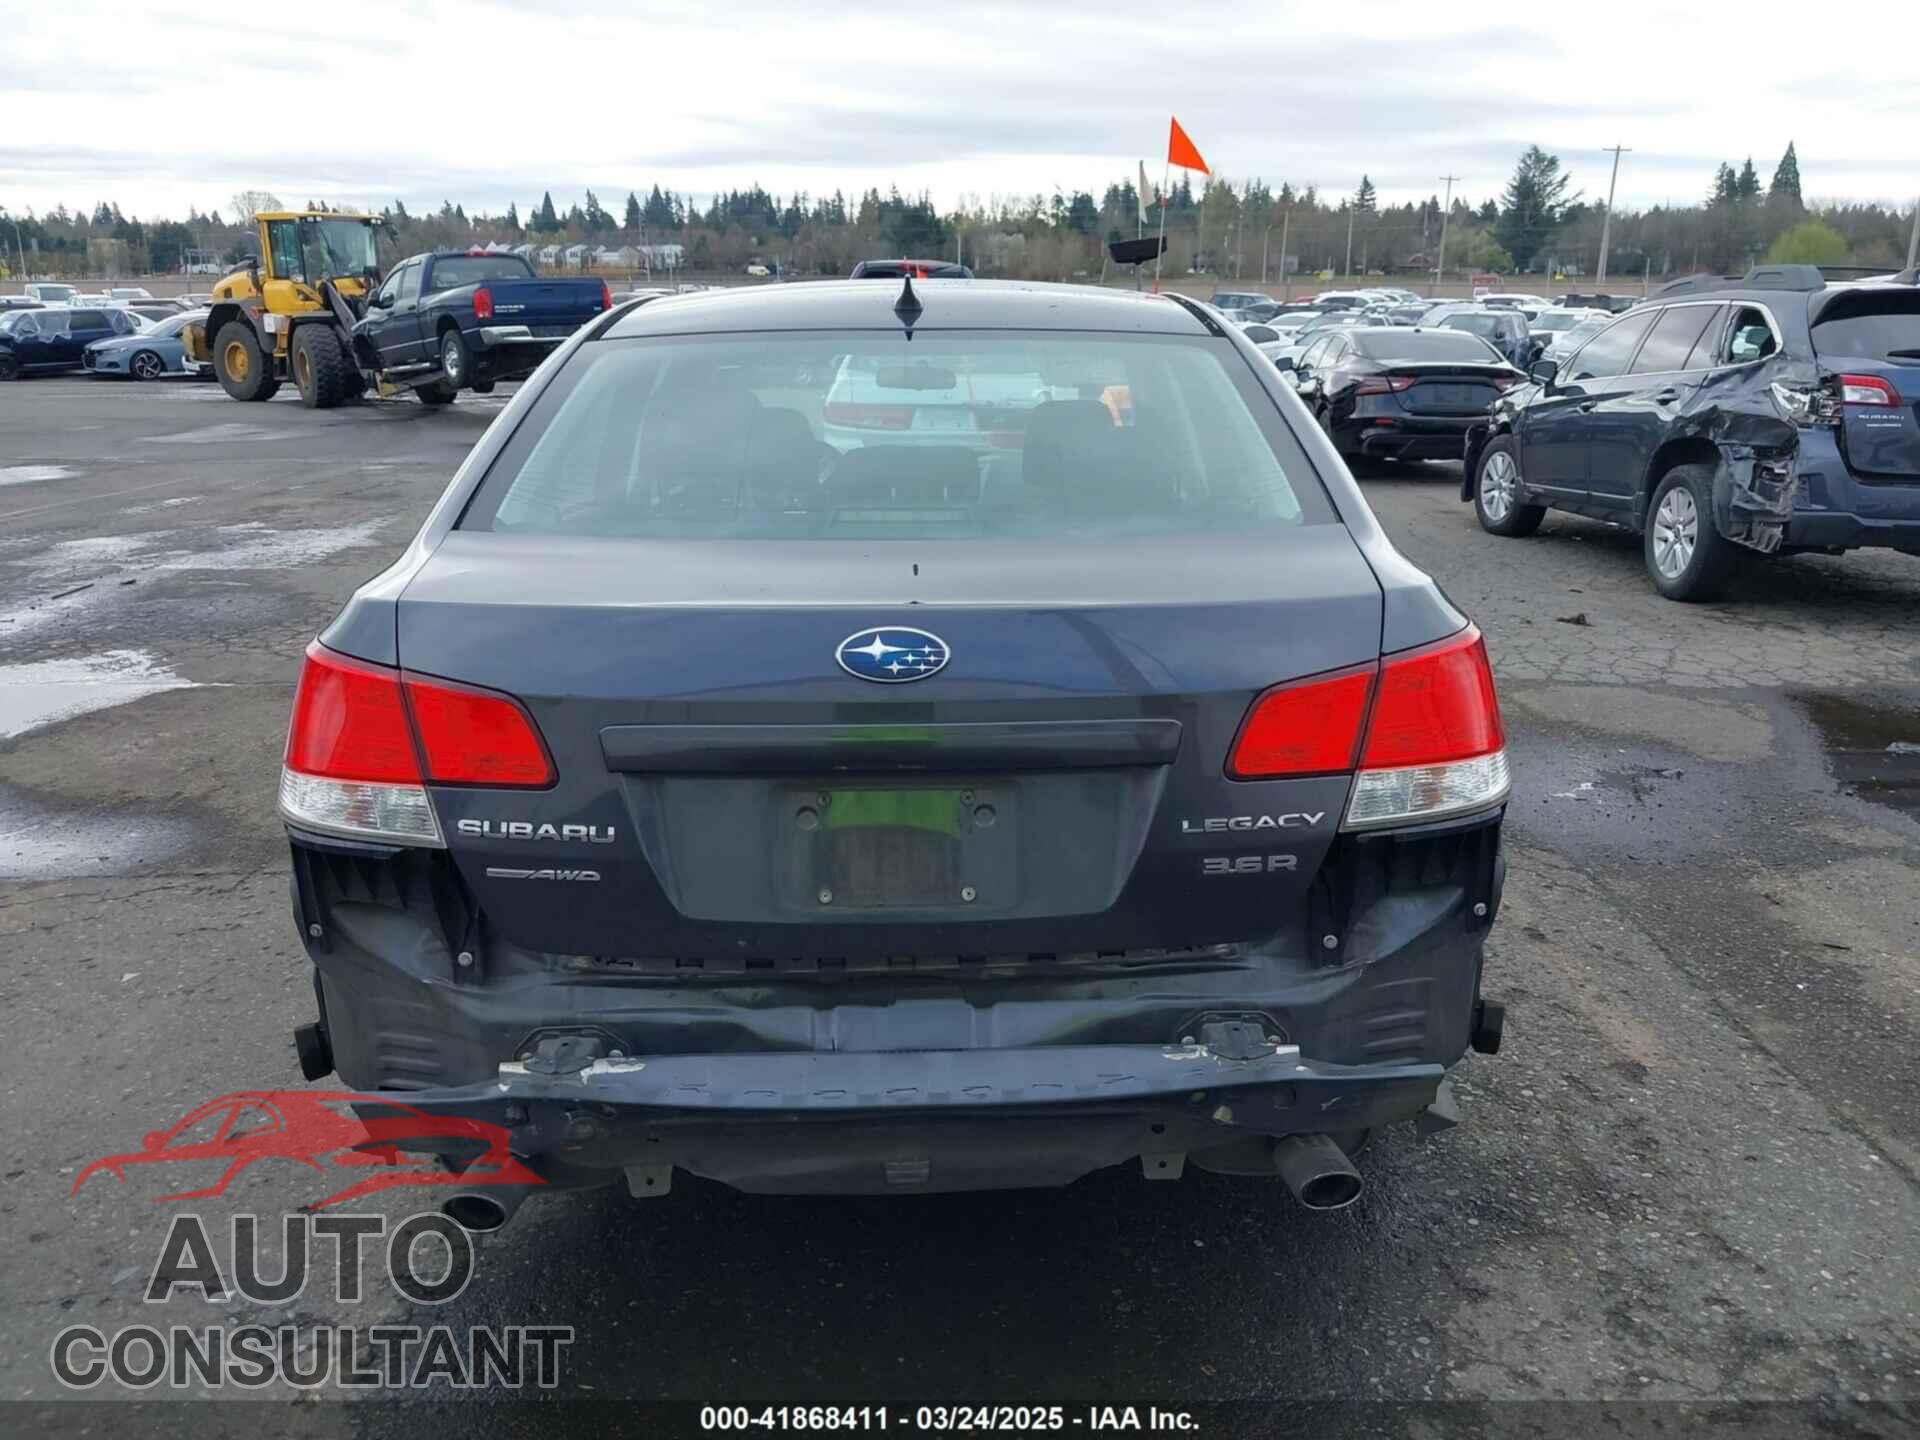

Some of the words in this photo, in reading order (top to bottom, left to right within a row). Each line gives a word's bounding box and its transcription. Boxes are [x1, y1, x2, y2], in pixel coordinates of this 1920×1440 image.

[457, 818, 615, 844] SUBARU
[1181, 811, 1326, 833] LEGACY
[529, 868, 601, 882] AWD
